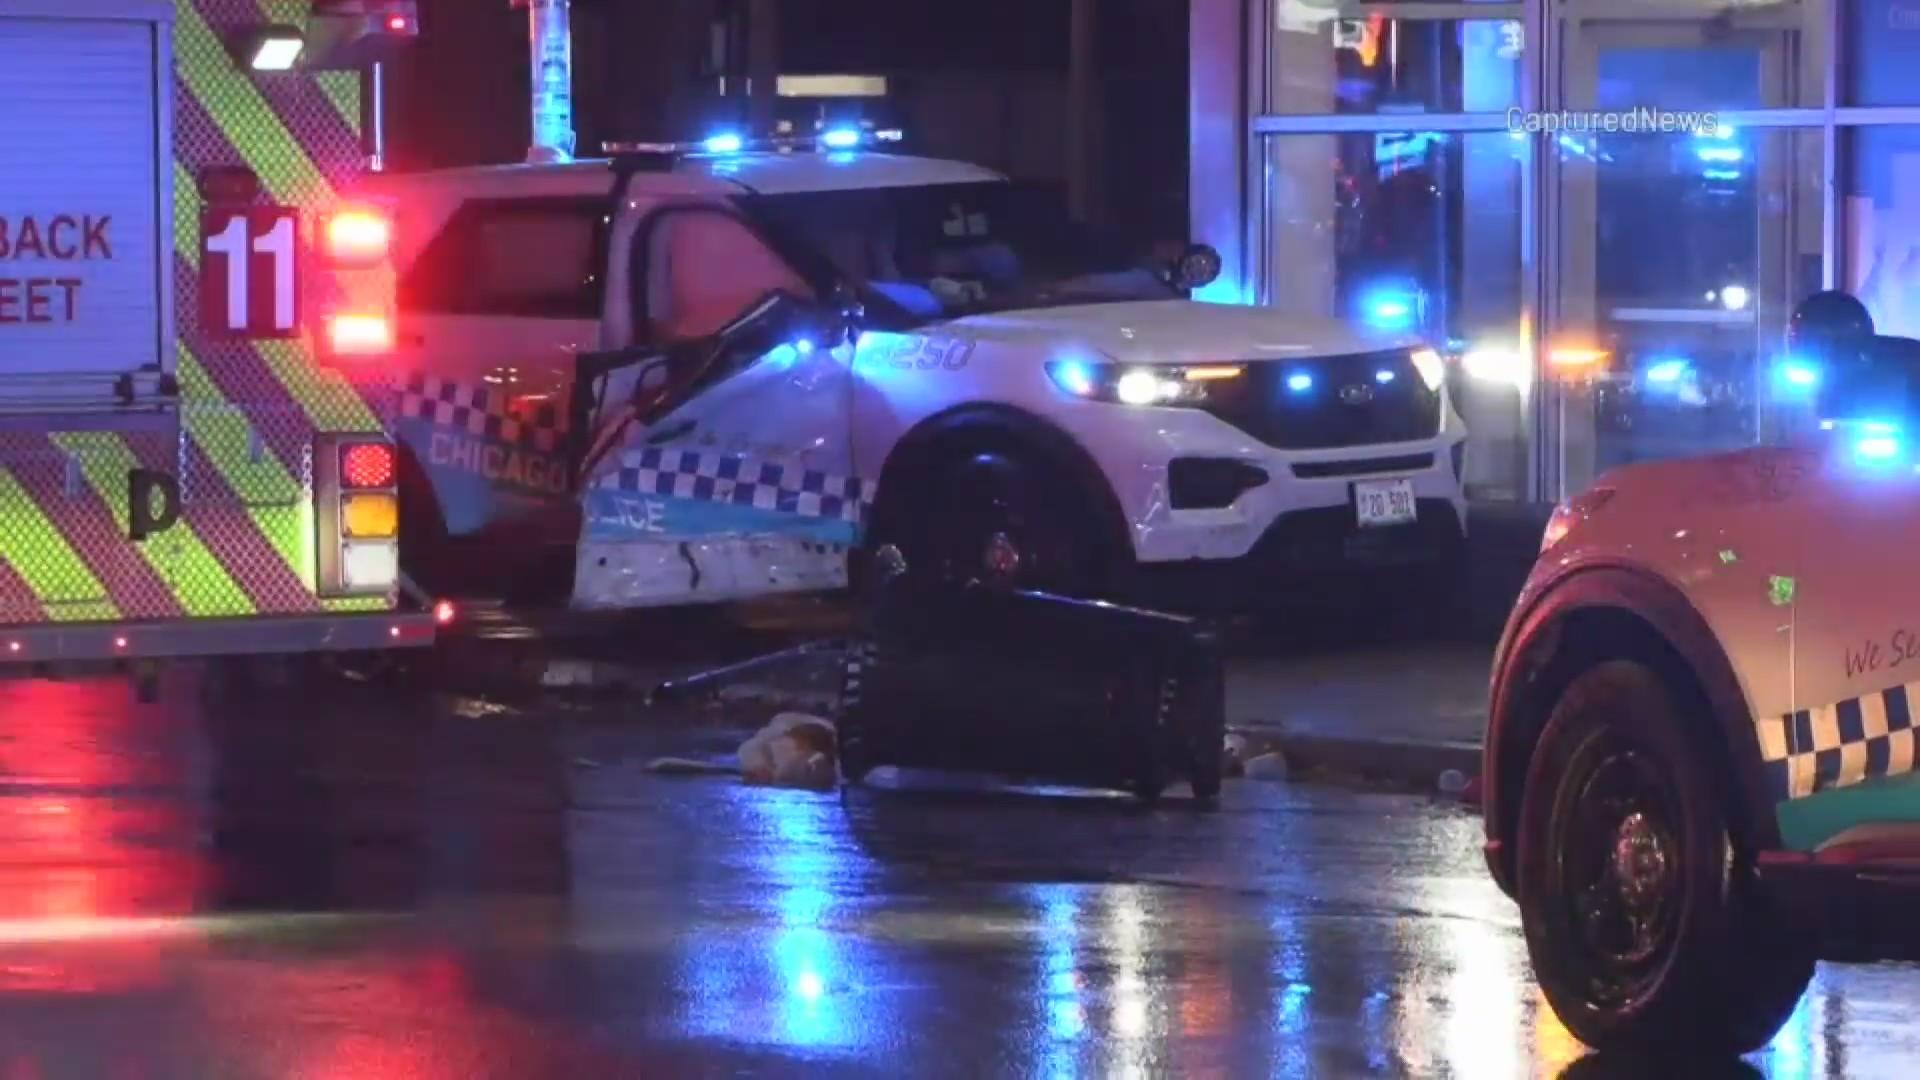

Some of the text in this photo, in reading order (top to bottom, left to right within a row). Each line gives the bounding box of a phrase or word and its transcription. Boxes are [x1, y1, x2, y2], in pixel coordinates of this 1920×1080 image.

[206, 215, 295, 330] 11
[428, 432, 568, 493] CHICAGO
[1844, 639, 1882, 679] We
